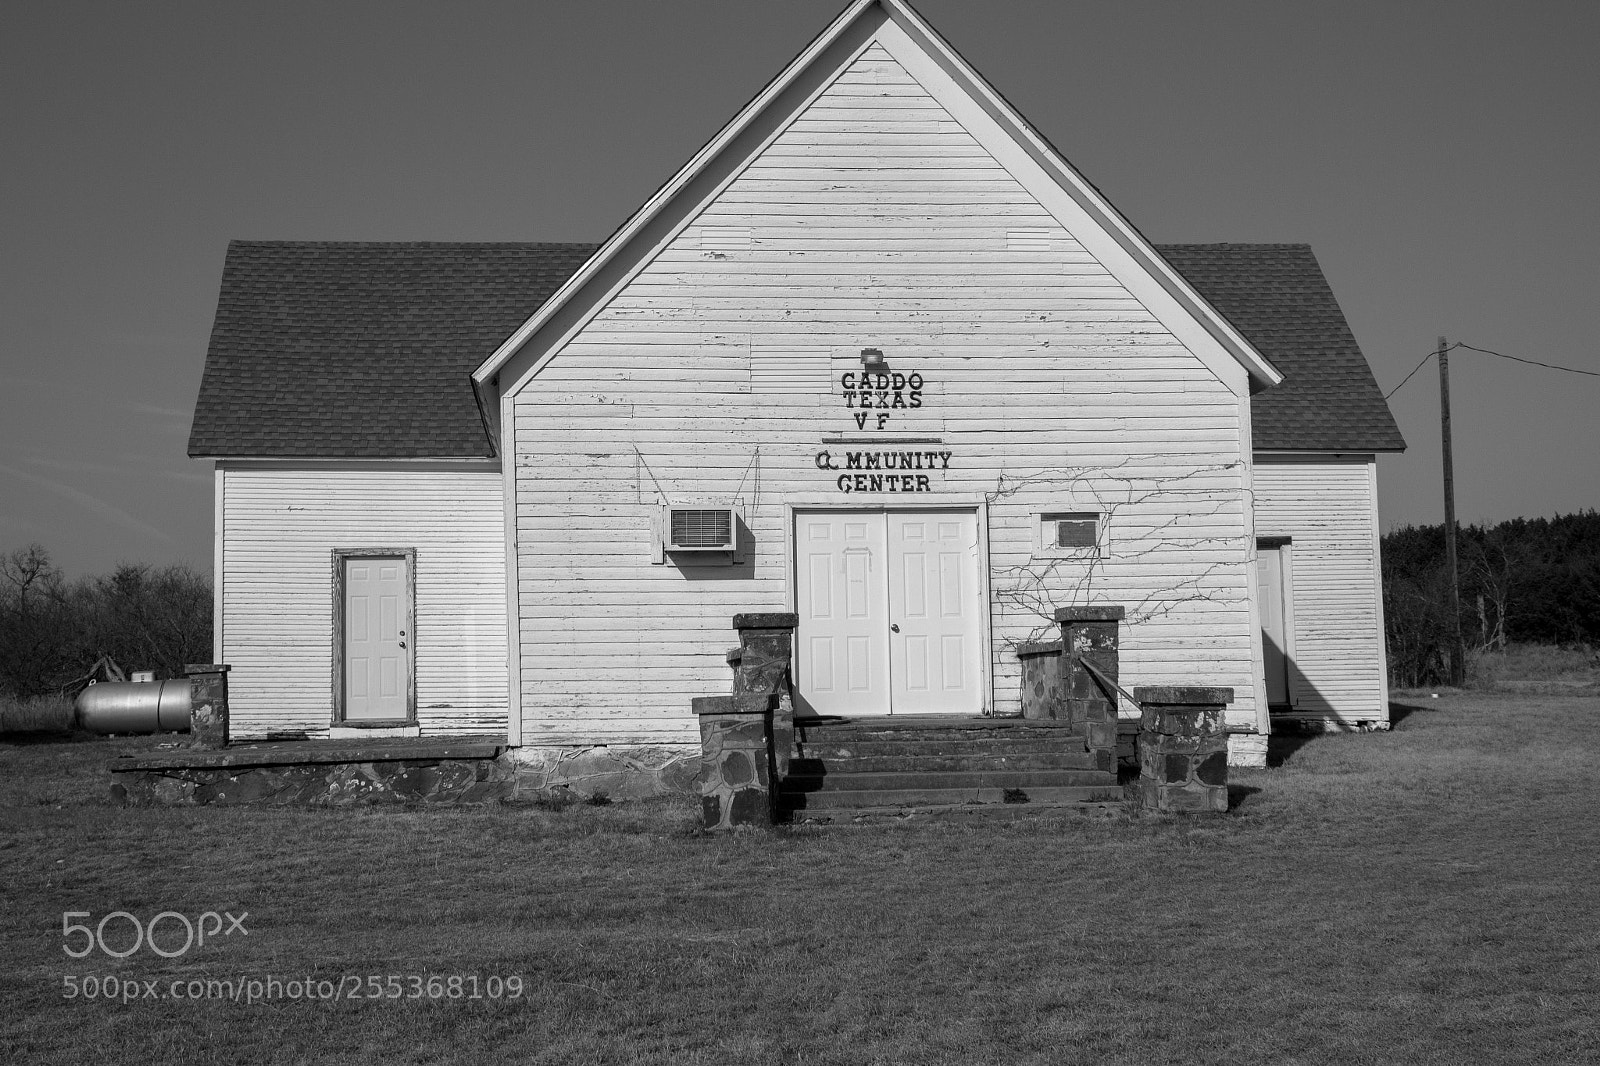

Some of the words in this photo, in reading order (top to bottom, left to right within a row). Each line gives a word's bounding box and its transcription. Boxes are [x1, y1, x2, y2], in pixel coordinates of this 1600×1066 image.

[841, 372, 923, 390] CADDO
[843, 391, 922, 409] TEXAS
[837, 474, 931, 494] CENTER
